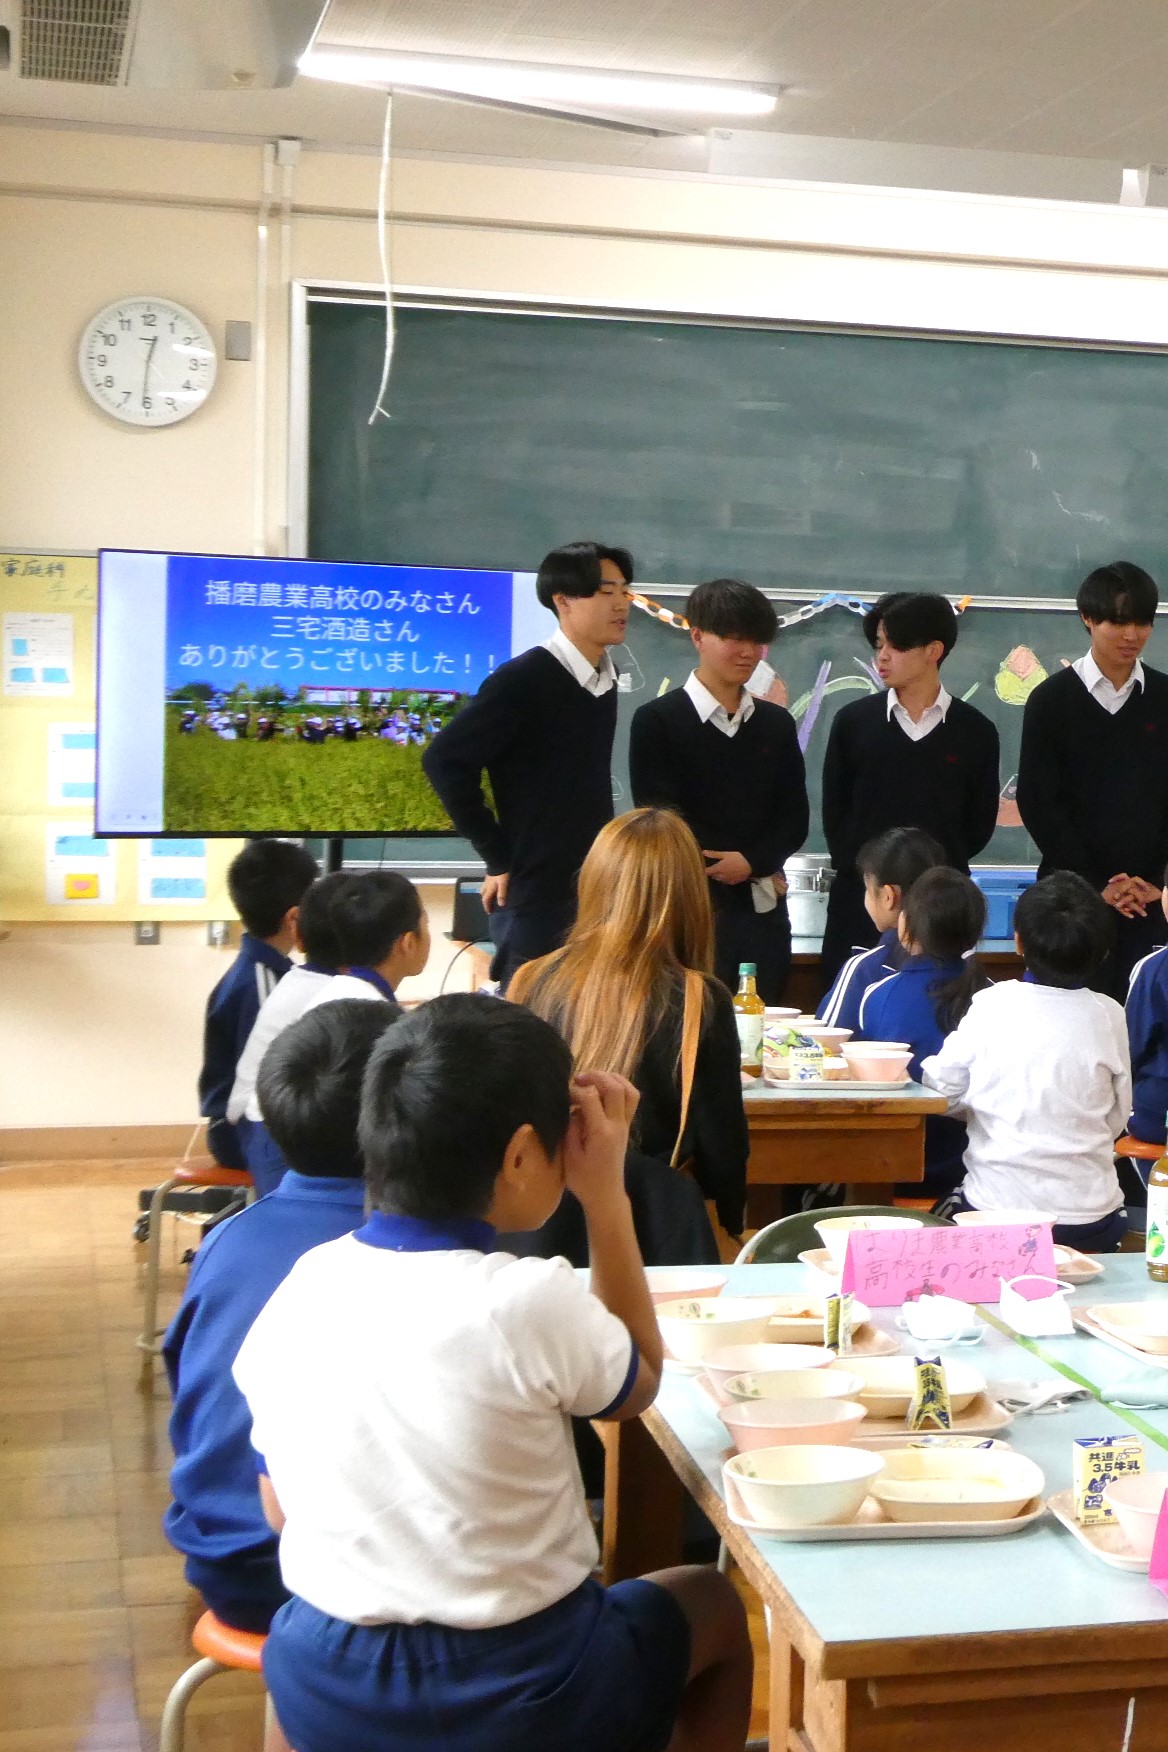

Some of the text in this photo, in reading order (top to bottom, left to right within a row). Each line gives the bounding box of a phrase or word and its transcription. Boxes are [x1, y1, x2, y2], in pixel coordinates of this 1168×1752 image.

[119, 319, 131, 331] 11
[141, 314, 157, 326] 12
[169, 322, 175, 333] 1
[102, 334, 117, 346] 10
[183, 337, 192, 346] 2
[97, 355, 107, 367] 9
[189, 358, 199, 371] 3
[104, 376, 114, 388] 8
[182, 380, 192, 391] 4
[122, 391, 132, 404] 7
[142, 397, 152, 409] 6
[204, 579, 481, 616] 播磨農業高校のみなさん
[270, 615, 420, 643] 三宅酒造さん
